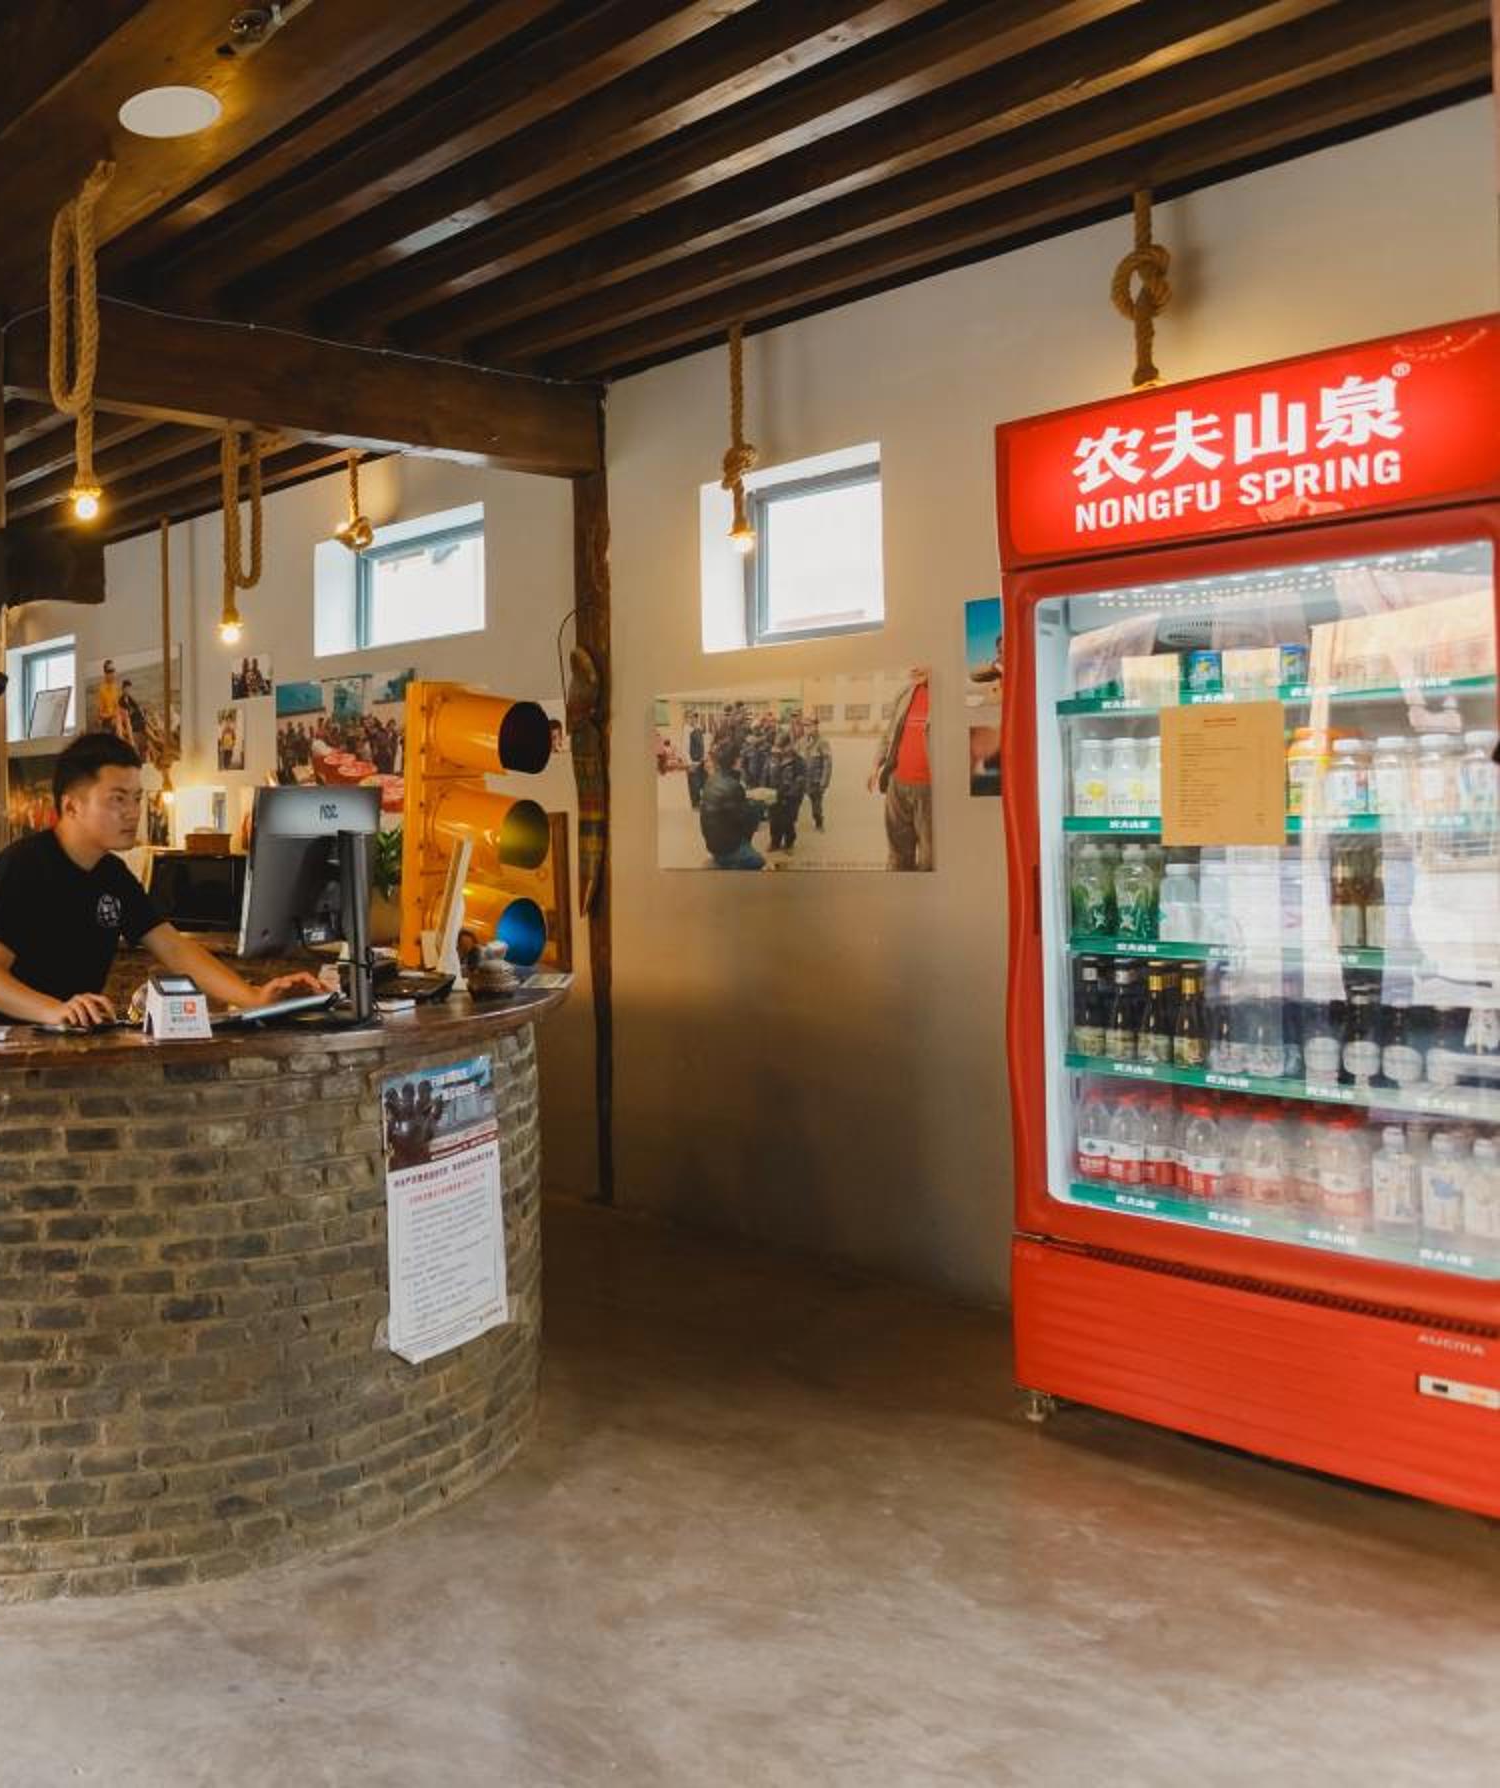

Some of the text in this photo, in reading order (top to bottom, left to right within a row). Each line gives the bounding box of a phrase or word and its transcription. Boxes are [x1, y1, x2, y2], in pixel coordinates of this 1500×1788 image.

[1072, 375, 1404, 494] 农夫山泉
[1074, 449, 1402, 533] NONGFU SPRING
